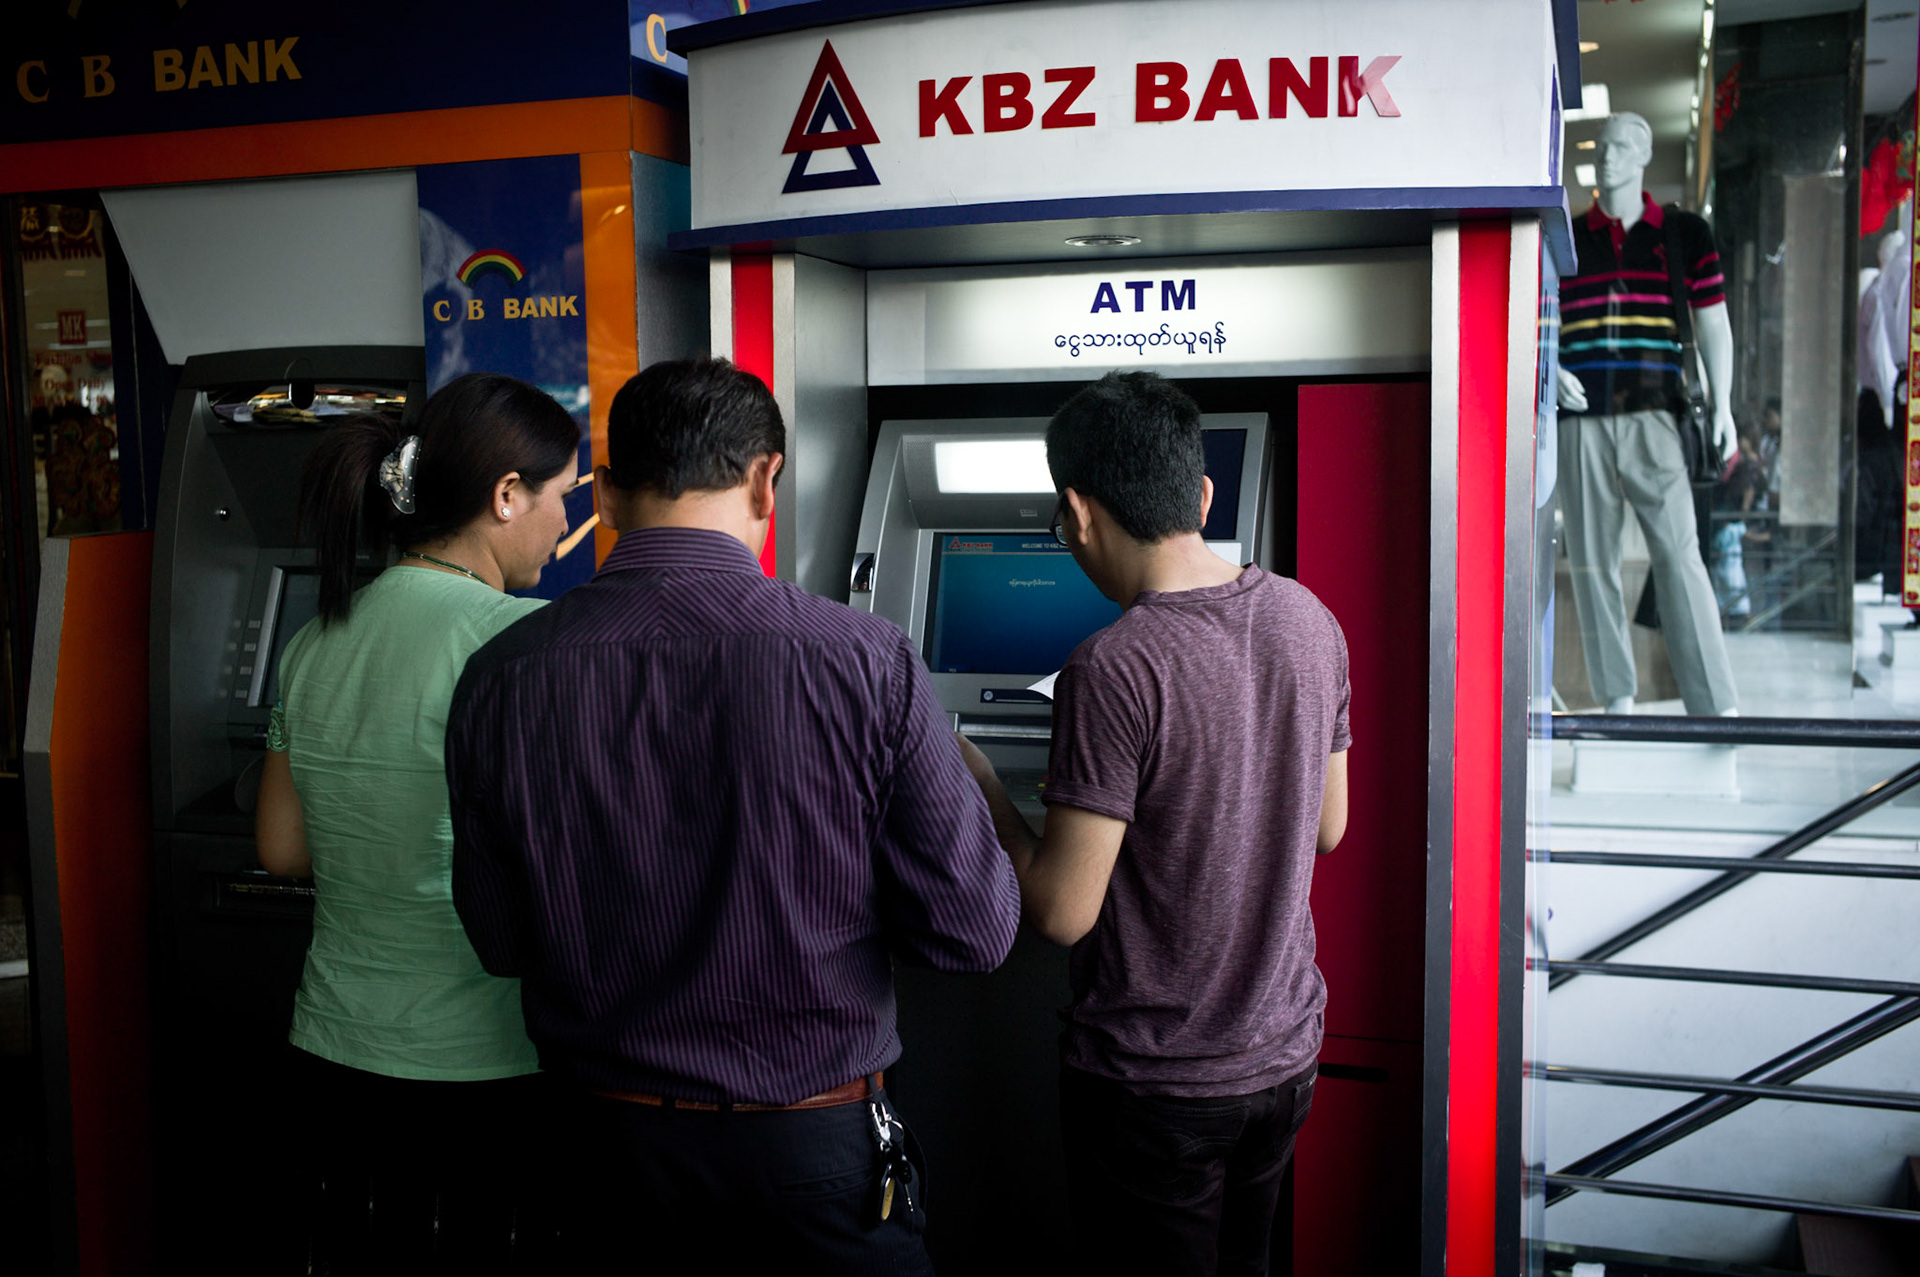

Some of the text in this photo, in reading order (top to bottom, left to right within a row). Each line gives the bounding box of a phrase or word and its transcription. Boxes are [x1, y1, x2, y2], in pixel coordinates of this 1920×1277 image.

[16, 36, 302, 103] C B BANK
[918, 55, 1403, 138] KBZ BANK
[432, 295, 579, 322] C B BANK
[1090, 278, 1197, 314] ATM
